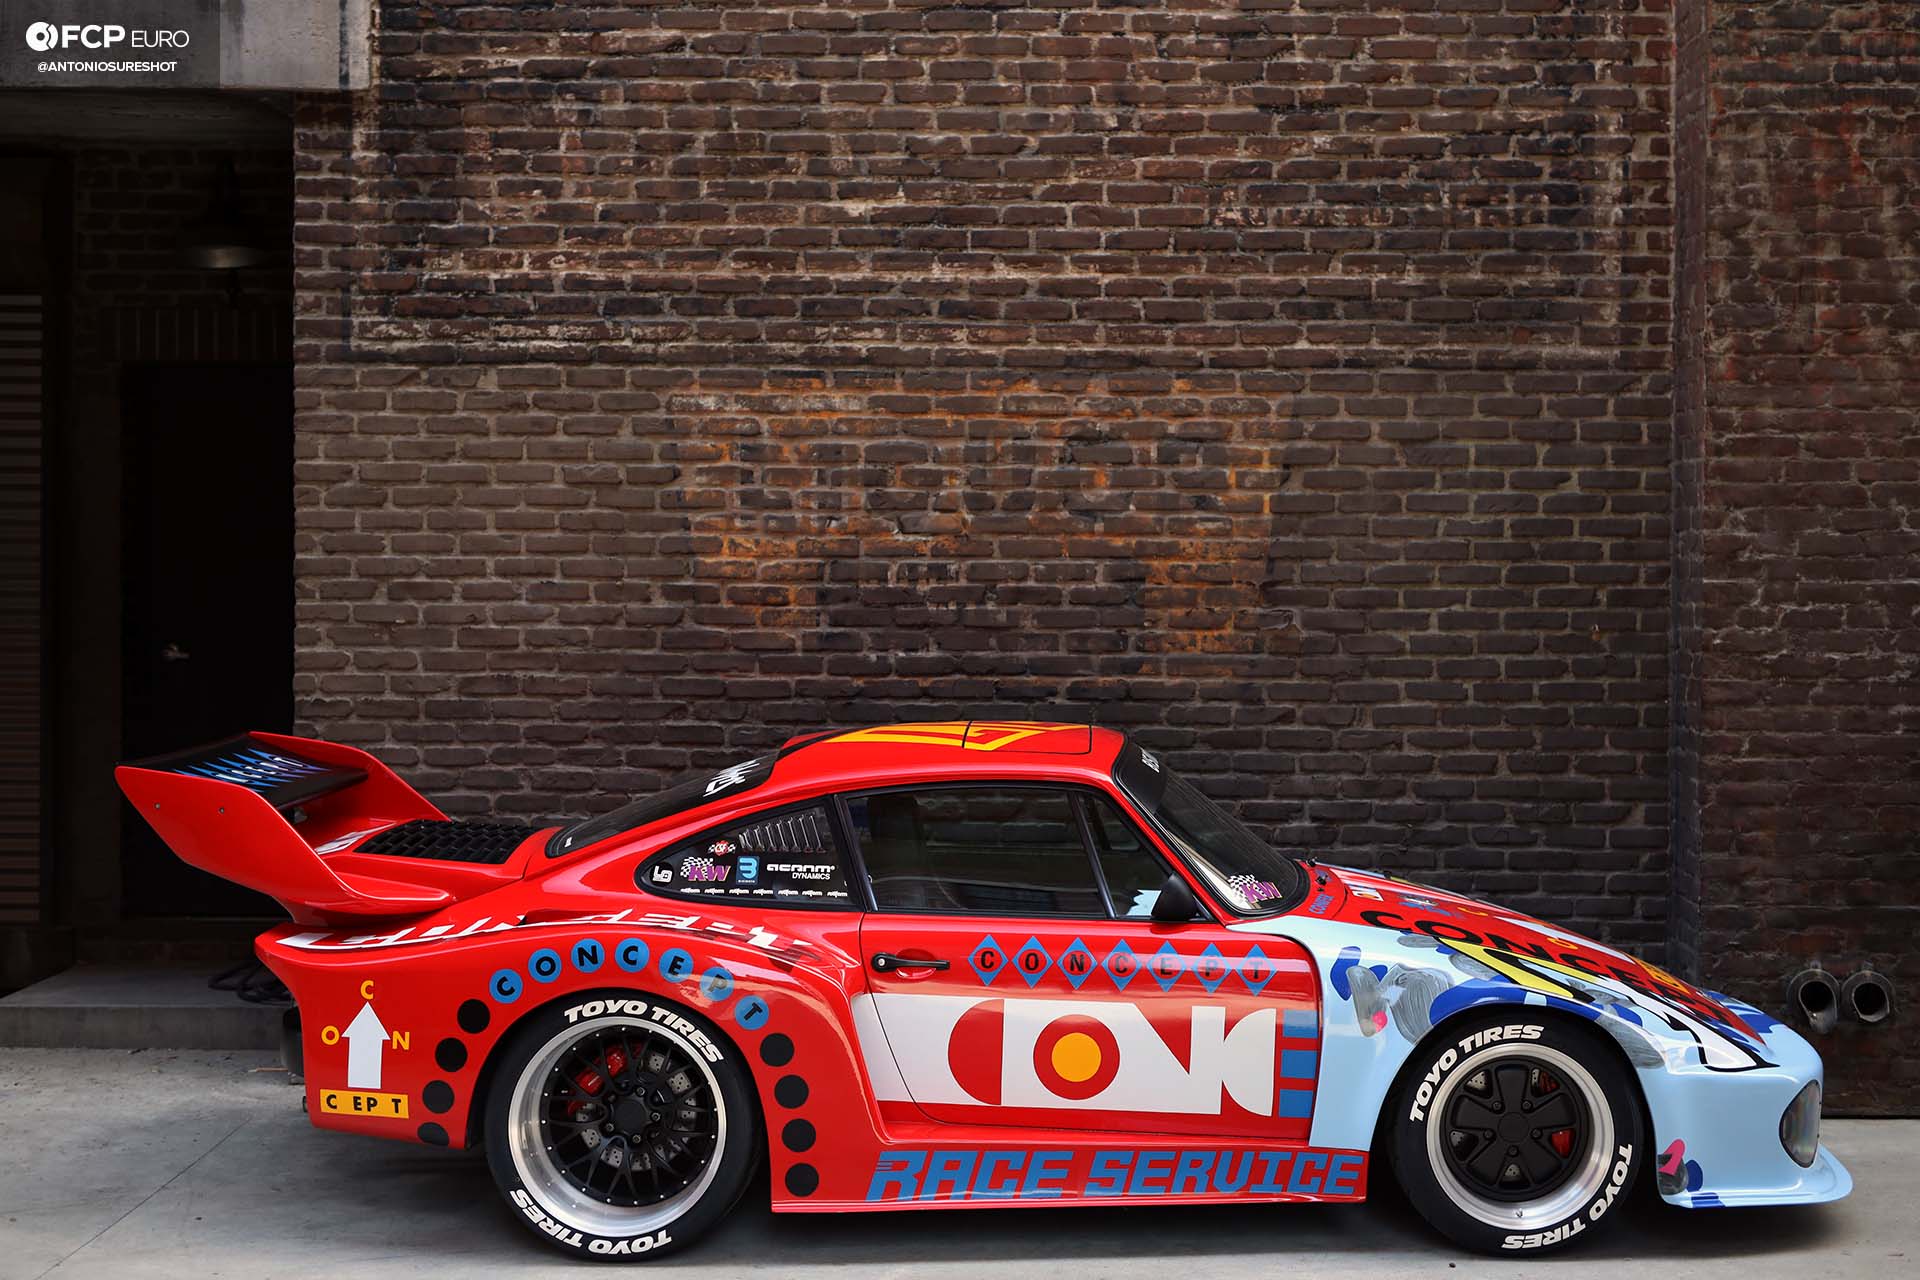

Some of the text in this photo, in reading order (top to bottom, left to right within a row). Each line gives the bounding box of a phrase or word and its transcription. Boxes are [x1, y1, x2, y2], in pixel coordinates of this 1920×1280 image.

[688, 864, 731, 882] KW
[791, 872, 831, 880] DYNAMICS
[1243, 880, 1283, 904] KW
[980, 948, 1265, 984] CONCEPT
[564, 999, 724, 1063] TOYO TIRES
[1409, 1024, 1545, 1122] TOYO TIRES
[866, 1150, 1367, 1202] RACE SERVICE
[1501, 1143, 1633, 1249] TOYO TIRES
[509, 1189, 673, 1255] TOYO TIRES
